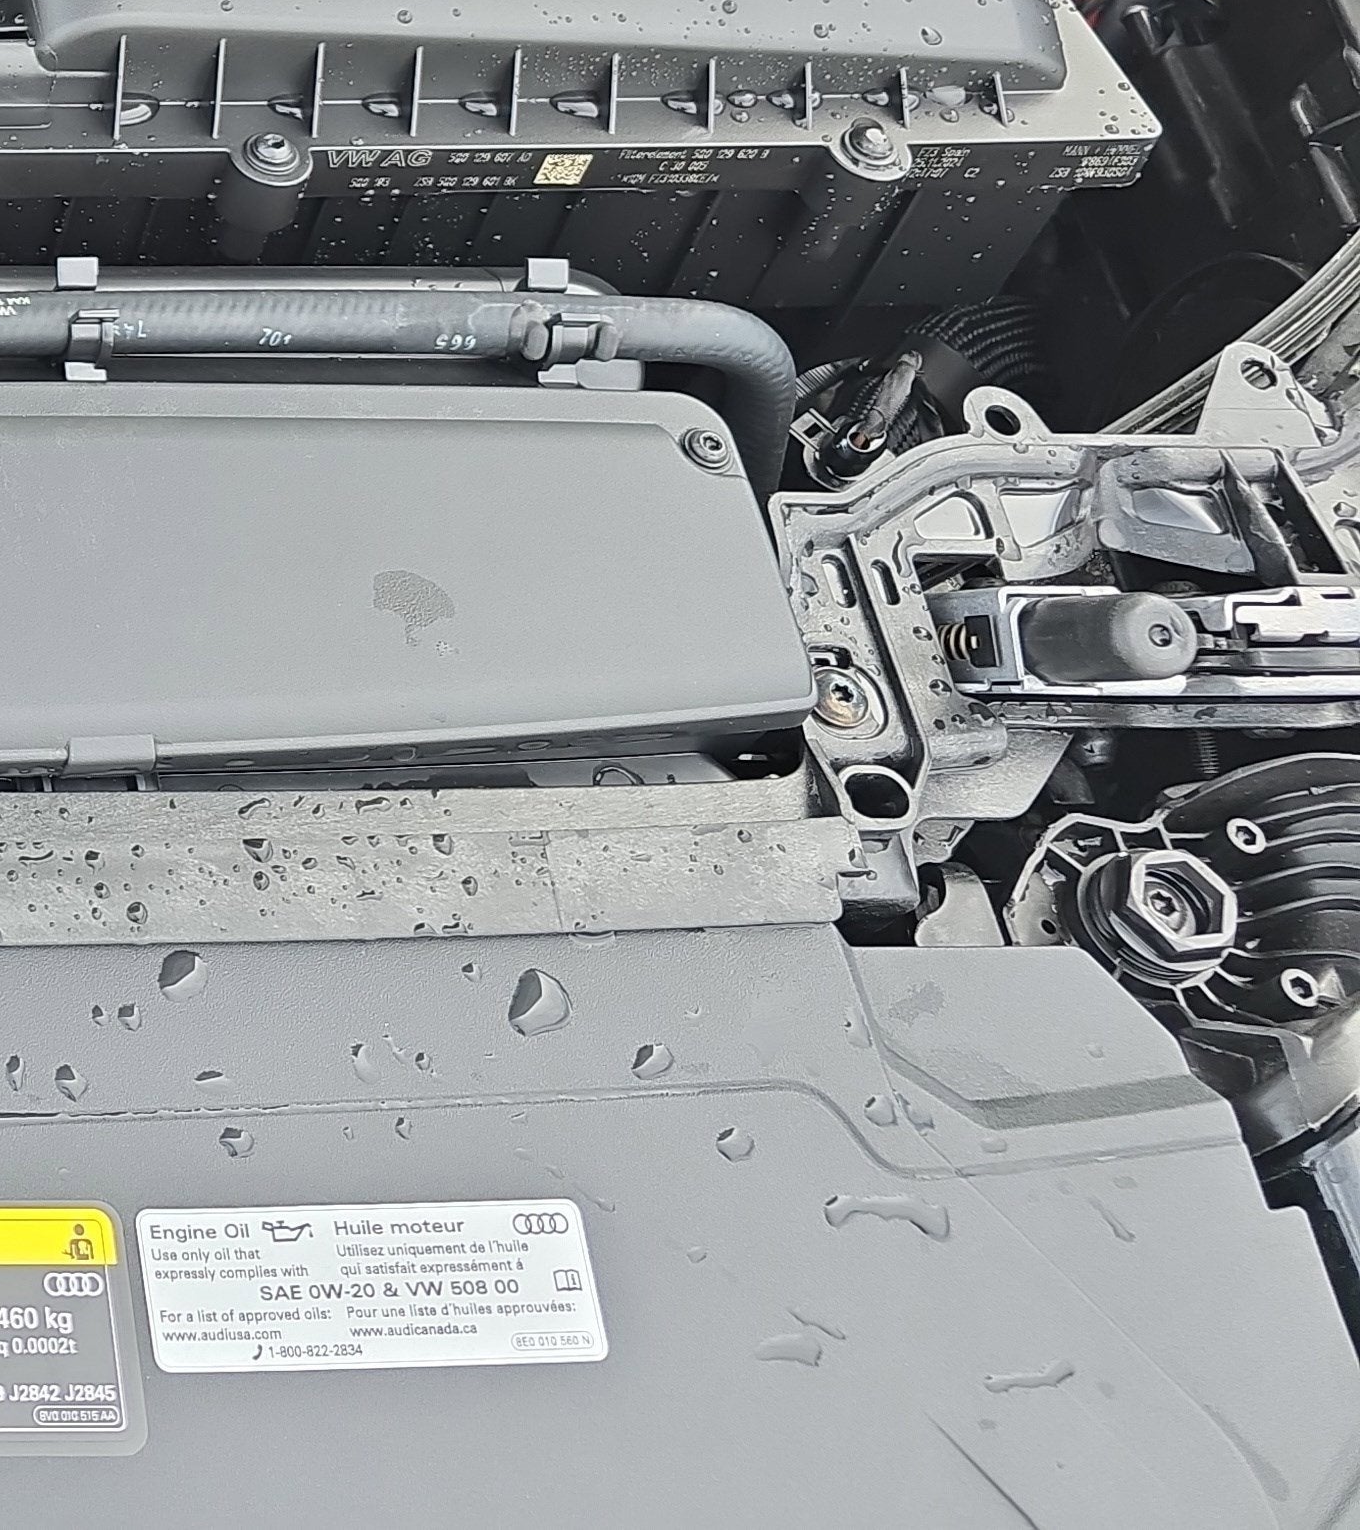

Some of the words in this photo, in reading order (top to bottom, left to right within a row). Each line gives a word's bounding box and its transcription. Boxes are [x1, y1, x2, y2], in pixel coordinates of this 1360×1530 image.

[328, 149, 381, 167] VW
[380, 149, 433, 167] AG
[150, 1225, 217, 1243] Engine
[224, 1223, 249, 1239] Oil
[335, 1220, 383, 1235] Huile
[391, 1220, 464, 1234] moteur
[151, 1248, 177, 1261] Use
[181, 1248, 210, 1263] only
[214, 1248, 230, 1261] oil
[234, 1248, 260, 1260] that
[336, 1244, 384, 1257] Utilisez
[387, 1242, 467, 1258] uniquement
[470, 1240, 485, 1254] de
[488, 1239, 529, 1253] l'huile
[155, 1267, 216, 1282] expressly
[220, 1266, 277, 1281] complies
[280, 1264, 309, 1277] with
[340, 1263, 362, 1279] qui
[365, 1261, 416, 1275] satisfait
[420, 1259, 512, 1277] expressément
[260, 1285, 302, 1301] SAE
[308, 1283, 375, 1299] 0W-20
[383, 1282, 401, 1298] &
[405, 1280, 443, 1296] VW
[450, 1280, 488, 1296] 508
[494, 1278, 519, 1294] 00
[159, 1310, 181, 1323] For
[186, 1313, 194, 1322] a
[197, 1309, 218, 1322] list
[221, 1309, 235, 1322] of
[238, 1307, 301, 1324] approved
[304, 1307, 332, 1320] oils:
[347, 1306, 377, 1318] Pour
[381, 1307, 406, 1317] une
[409, 1303, 437, 1317] liste
[441, 1302, 493, 1316] d'huiles
[496, 1301, 576, 1318] approuvées:
[44, 1306, 74, 1334] kg
[162, 1328, 282, 1342] www.audiusa.com
[349, 1323, 477, 1338] www.audicanada.ca
[12, 1336, 78, 1354] 0.0002t
[581, 1335, 591, 1345] N
[268, 1343, 363, 1358] 1-800-822-2834
[9, 1384, 60, 1401] J2842
[64, 1384, 117, 1401] J2845
[99, 1410, 116, 1421] AA
